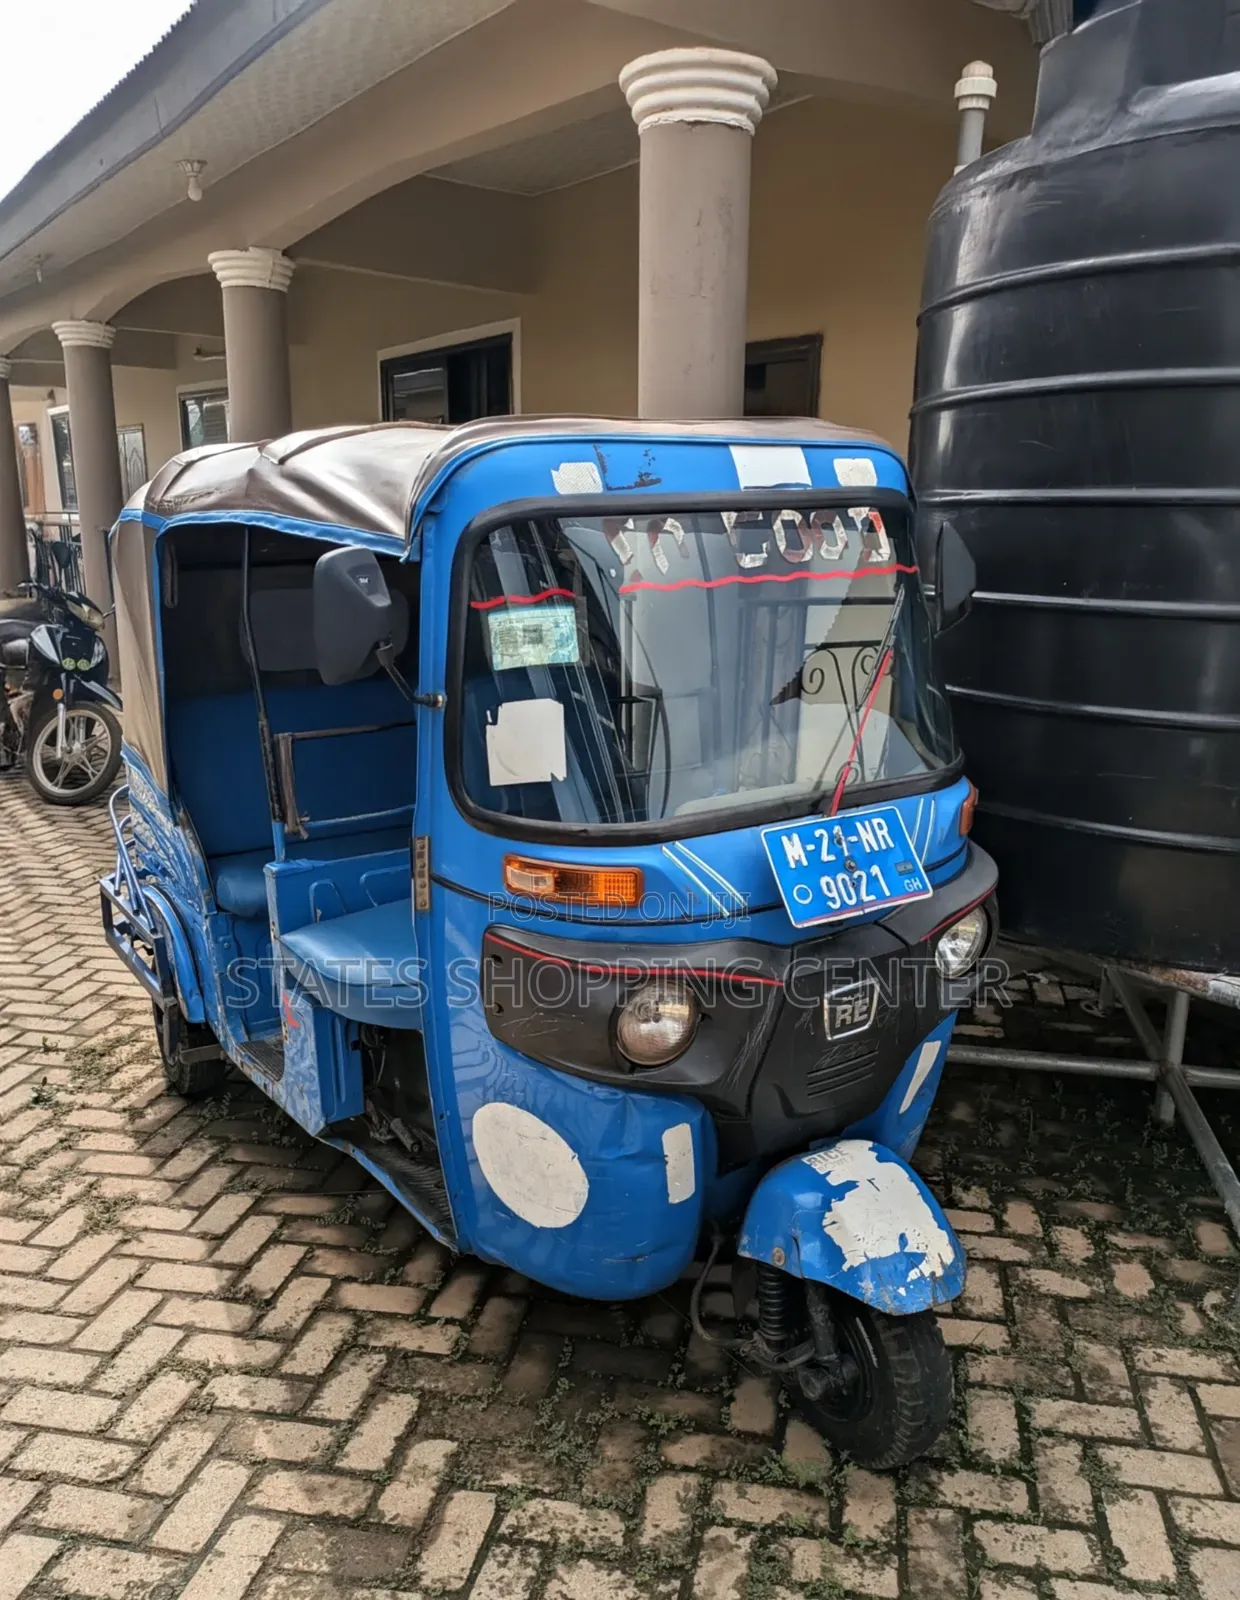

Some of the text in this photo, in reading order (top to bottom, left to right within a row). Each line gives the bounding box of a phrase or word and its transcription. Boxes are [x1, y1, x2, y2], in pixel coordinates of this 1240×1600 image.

[781, 818, 895, 869] M-21-NR
[820, 864, 891, 909] 9021
[904, 877, 923, 892] GH
[835, 997, 869, 1029] RE
